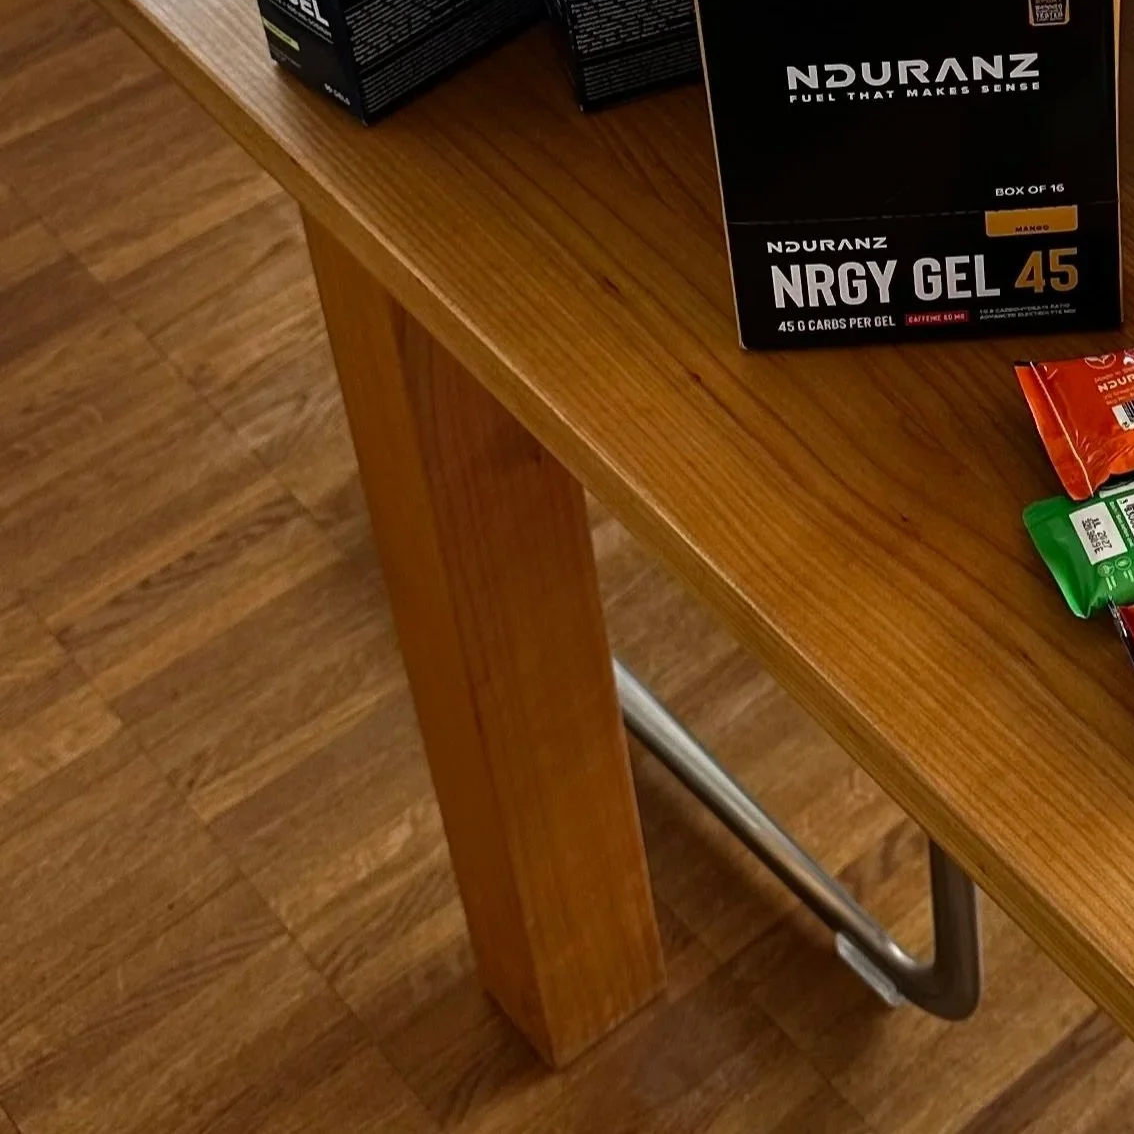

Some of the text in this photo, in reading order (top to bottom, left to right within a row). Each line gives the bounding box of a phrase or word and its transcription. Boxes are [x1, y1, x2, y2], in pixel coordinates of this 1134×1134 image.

[786, 53, 1040, 90] NDURANZ
[790, 81, 1040, 103] FUEL THAT MAKES SENSE
[995, 183, 1065, 197] BOX OF 16
[766, 236, 888, 254] NDURANZ
[770, 247, 1079, 308] NRGY GEL 45
[778, 315, 896, 333] 45 CARBS PER GEL
